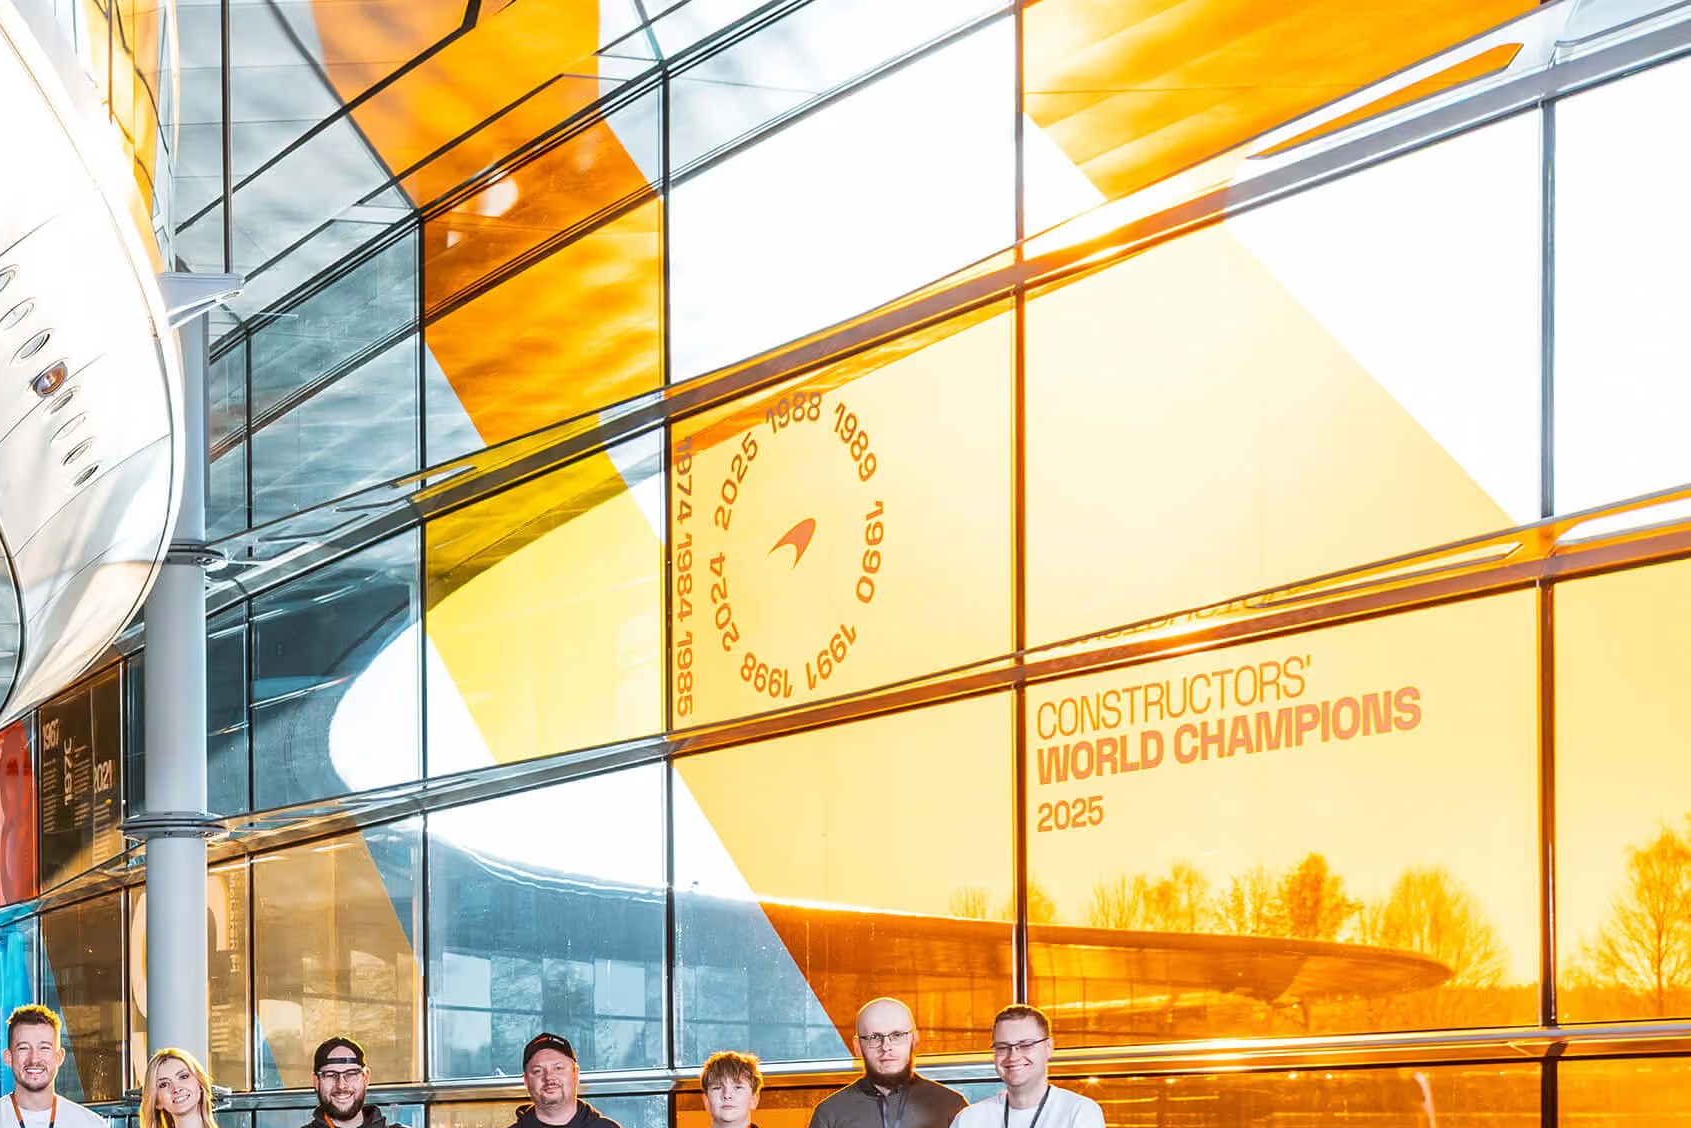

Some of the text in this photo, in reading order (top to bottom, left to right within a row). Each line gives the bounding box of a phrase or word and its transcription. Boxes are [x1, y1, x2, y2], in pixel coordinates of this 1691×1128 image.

[676, 436, 693, 717] 1974 1984 1985
[709, 392, 884, 698] 1988 1989 1990 1991 1998 2024 2025
[1037, 654, 1312, 740] CONSTRUCTORS'
[1037, 686, 1421, 785] WORLD CHAMPIONS
[1037, 795, 1104, 833] 2025
